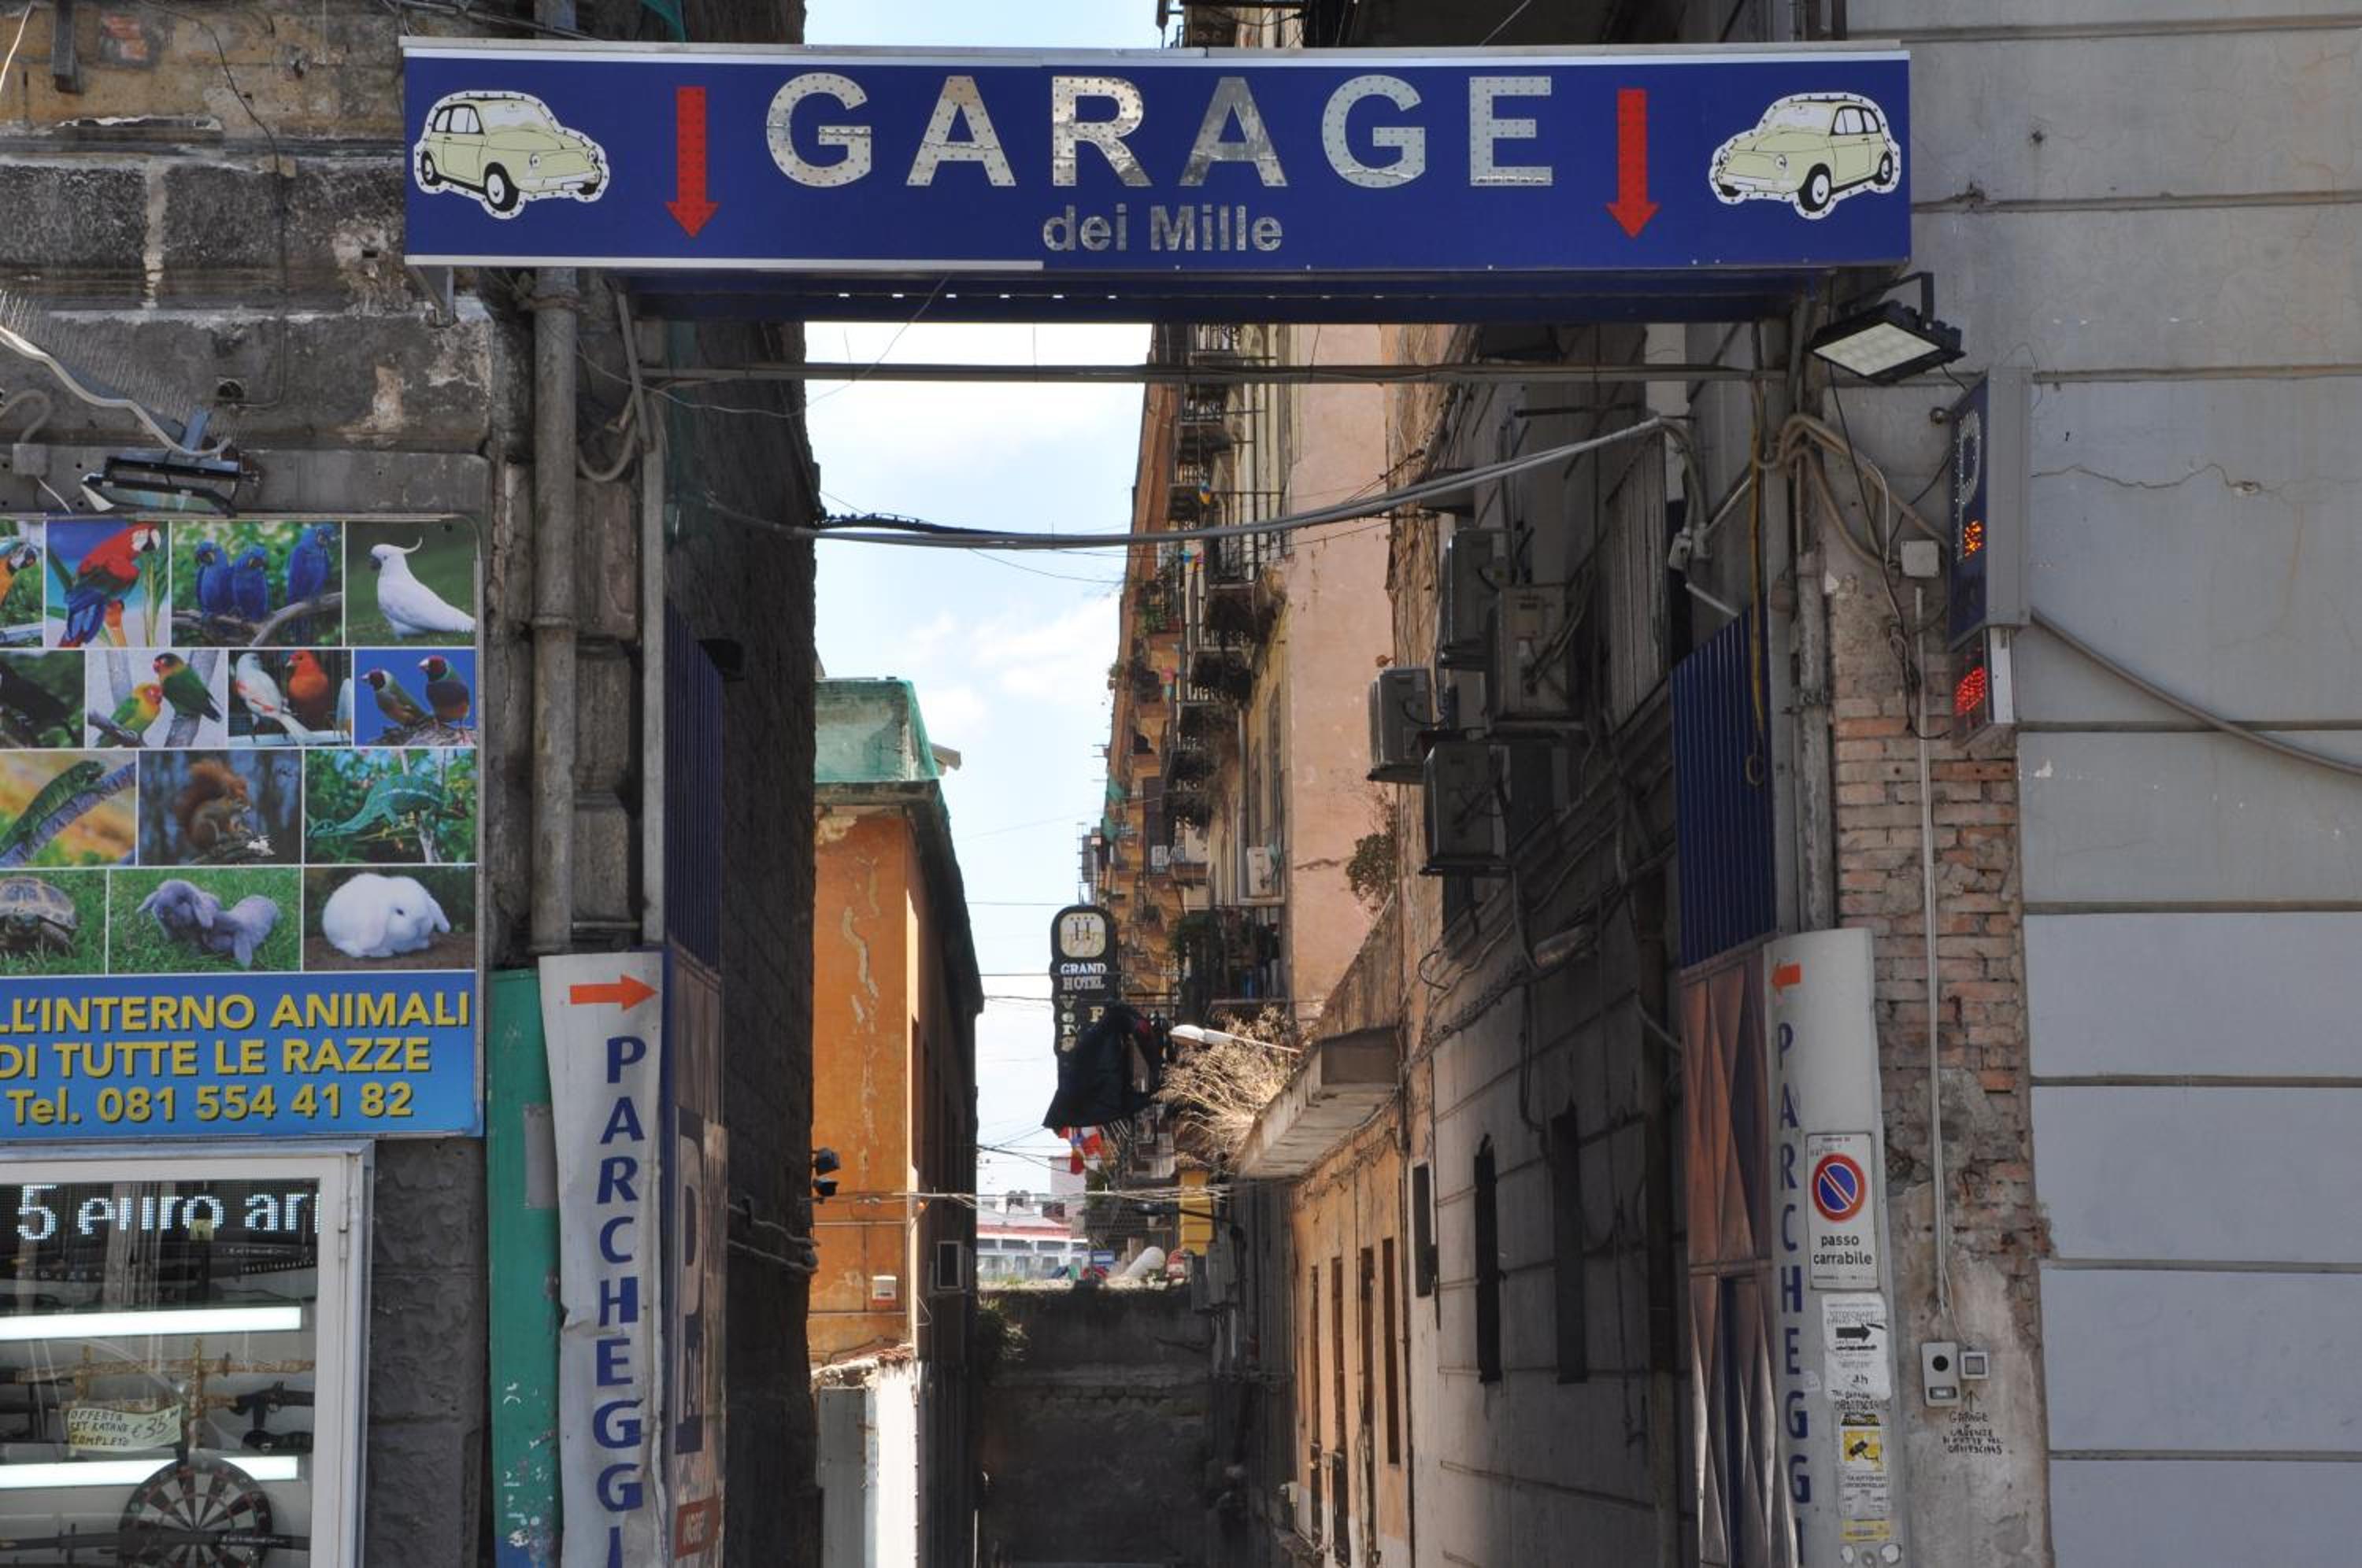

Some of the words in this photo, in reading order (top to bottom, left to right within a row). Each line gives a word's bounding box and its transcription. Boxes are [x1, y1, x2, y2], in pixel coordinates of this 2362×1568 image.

[766, 72, 1554, 189] GARAGE
[1043, 204, 1127, 251] dei
[1150, 204, 1283, 251] Mille
[1060, 963, 1107, 975] GRAND
[1062, 975, 1105, 991] HOTEL
[269, 991, 469, 1028] ANIMALI
[52, 1040, 198, 1078] TUTTE
[214, 1038, 266, 1075] LE
[282, 1037, 431, 1073] RAZZE
[6, 1086, 82, 1125] Tel.
[96, 1085, 176, 1123] 081
[194, 1083, 276, 1122] 554
[290, 1082, 340, 1119] 41
[359, 1082, 413, 1118] 82
[17, 1184, 57, 1241] 5
[1813, 1252, 1873, 1265] carrabile
[1820, 1235, 1860, 1248] passo
